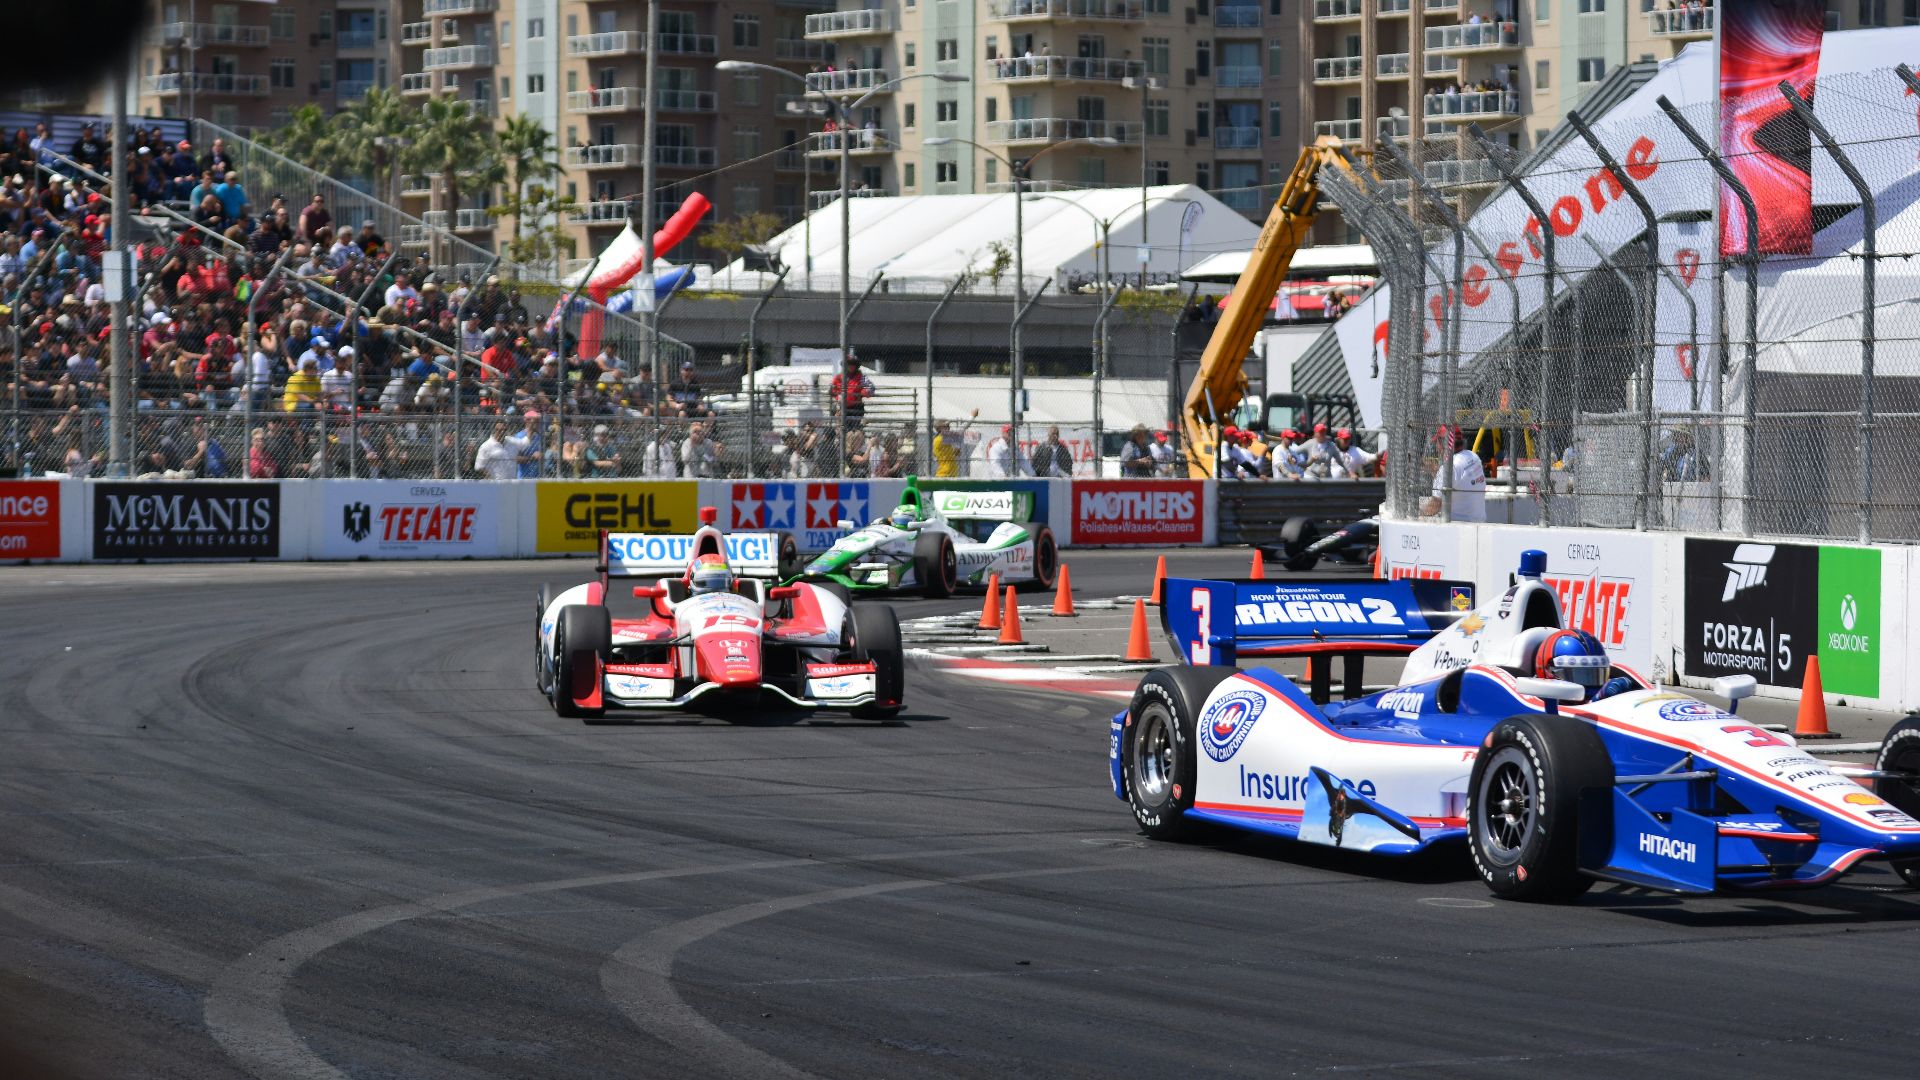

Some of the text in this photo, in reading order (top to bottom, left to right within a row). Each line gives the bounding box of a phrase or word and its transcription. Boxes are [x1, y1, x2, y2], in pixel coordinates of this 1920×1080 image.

[1374, 134, 1660, 358] restone
[410, 486, 447, 496] CERVEZA
[0, 495, 48, 516] nce
[104, 494, 270, 531] McMANIS
[564, 493, 671, 528] GEHL
[1080, 491, 1195, 520] MOTHERS
[379, 504, 477, 541] TECATE
[105, 534, 269, 545] FAMILY VINEYARDS
[609, 536, 769, 561] SCOUNG!
[806, 531, 850, 548] TAM
[1567, 543, 1601, 561] CERVEZA
[1235, 598, 1405, 625] RAGON 2
[1191, 587, 1211, 666] 3
[1704, 622, 1792, 672] FORZA 5
[1704, 651, 1767, 671] MOTORSPORT
[1215, 707, 1244, 728] AAA
[1240, 764, 1376, 801] Insure
[1640, 832, 1696, 863] HITACHI
